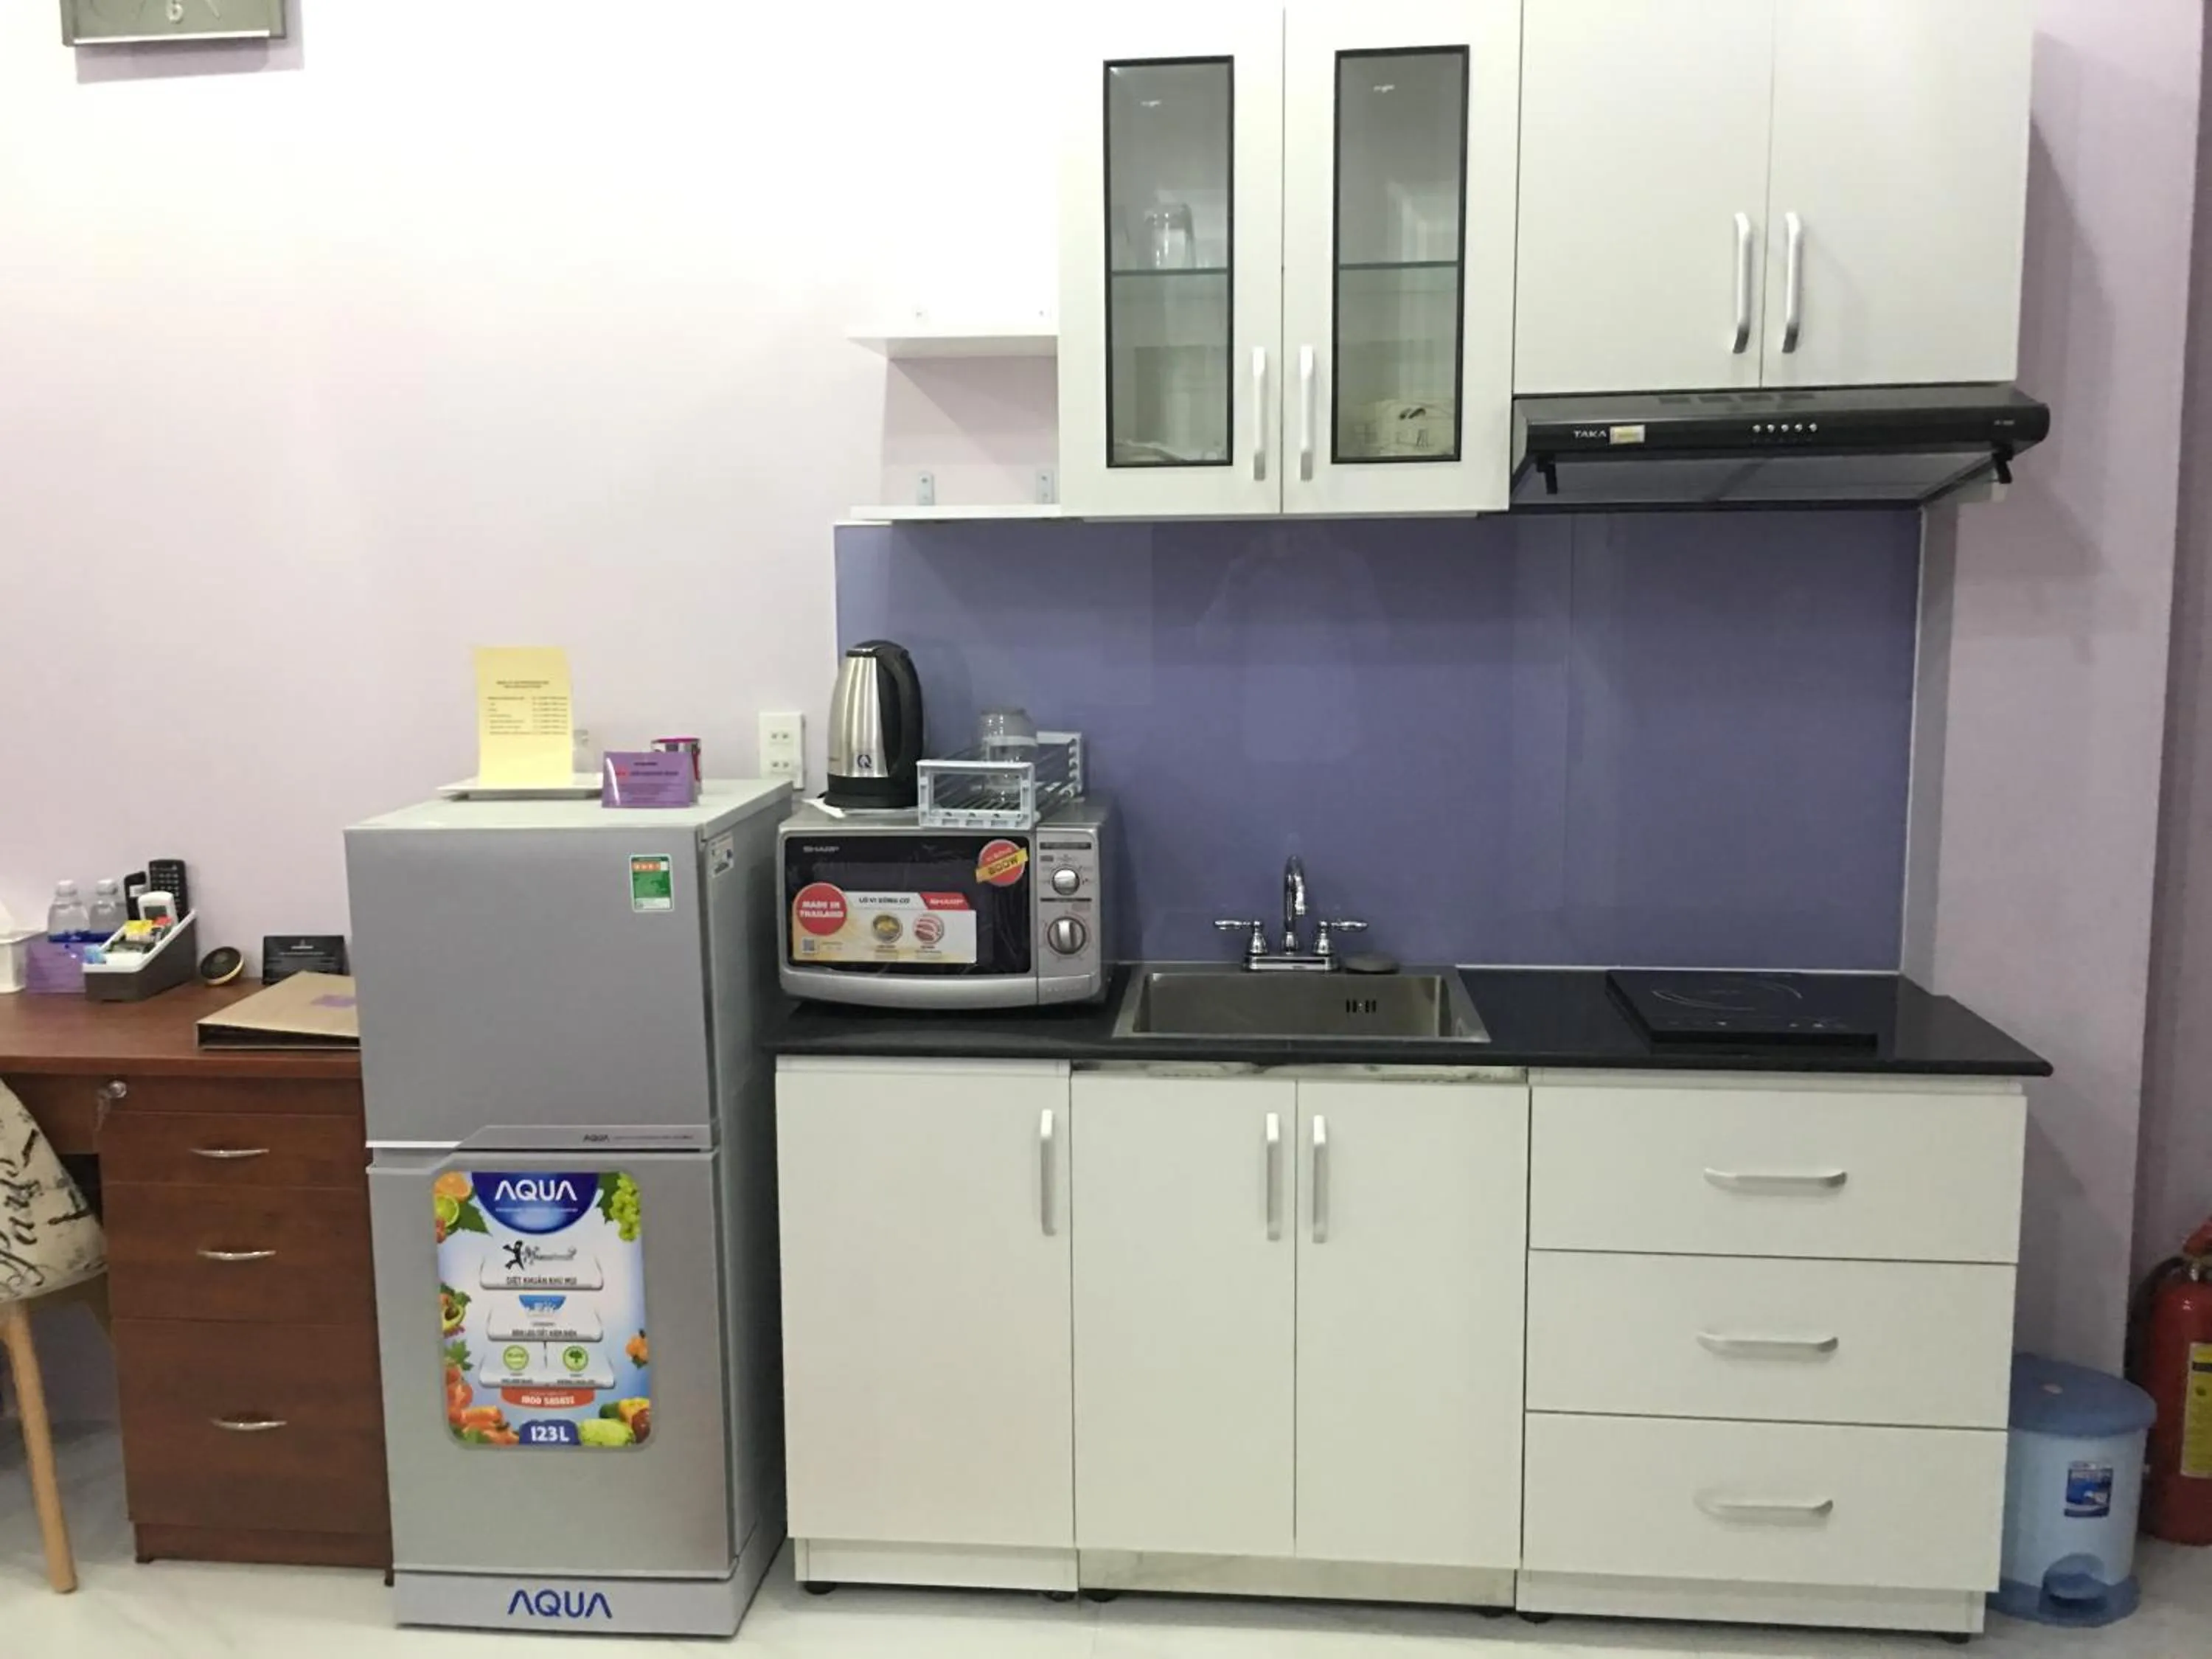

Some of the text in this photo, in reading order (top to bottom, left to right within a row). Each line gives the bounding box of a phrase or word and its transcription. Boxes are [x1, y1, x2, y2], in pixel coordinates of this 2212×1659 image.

[1573, 430, 1607, 439] TAKA
[802, 901, 827, 909] MADE
[799, 909, 844, 918] THAILAND
[494, 1179, 578, 1201] AQUA
[508, 1589, 613, 1618] AQUA
